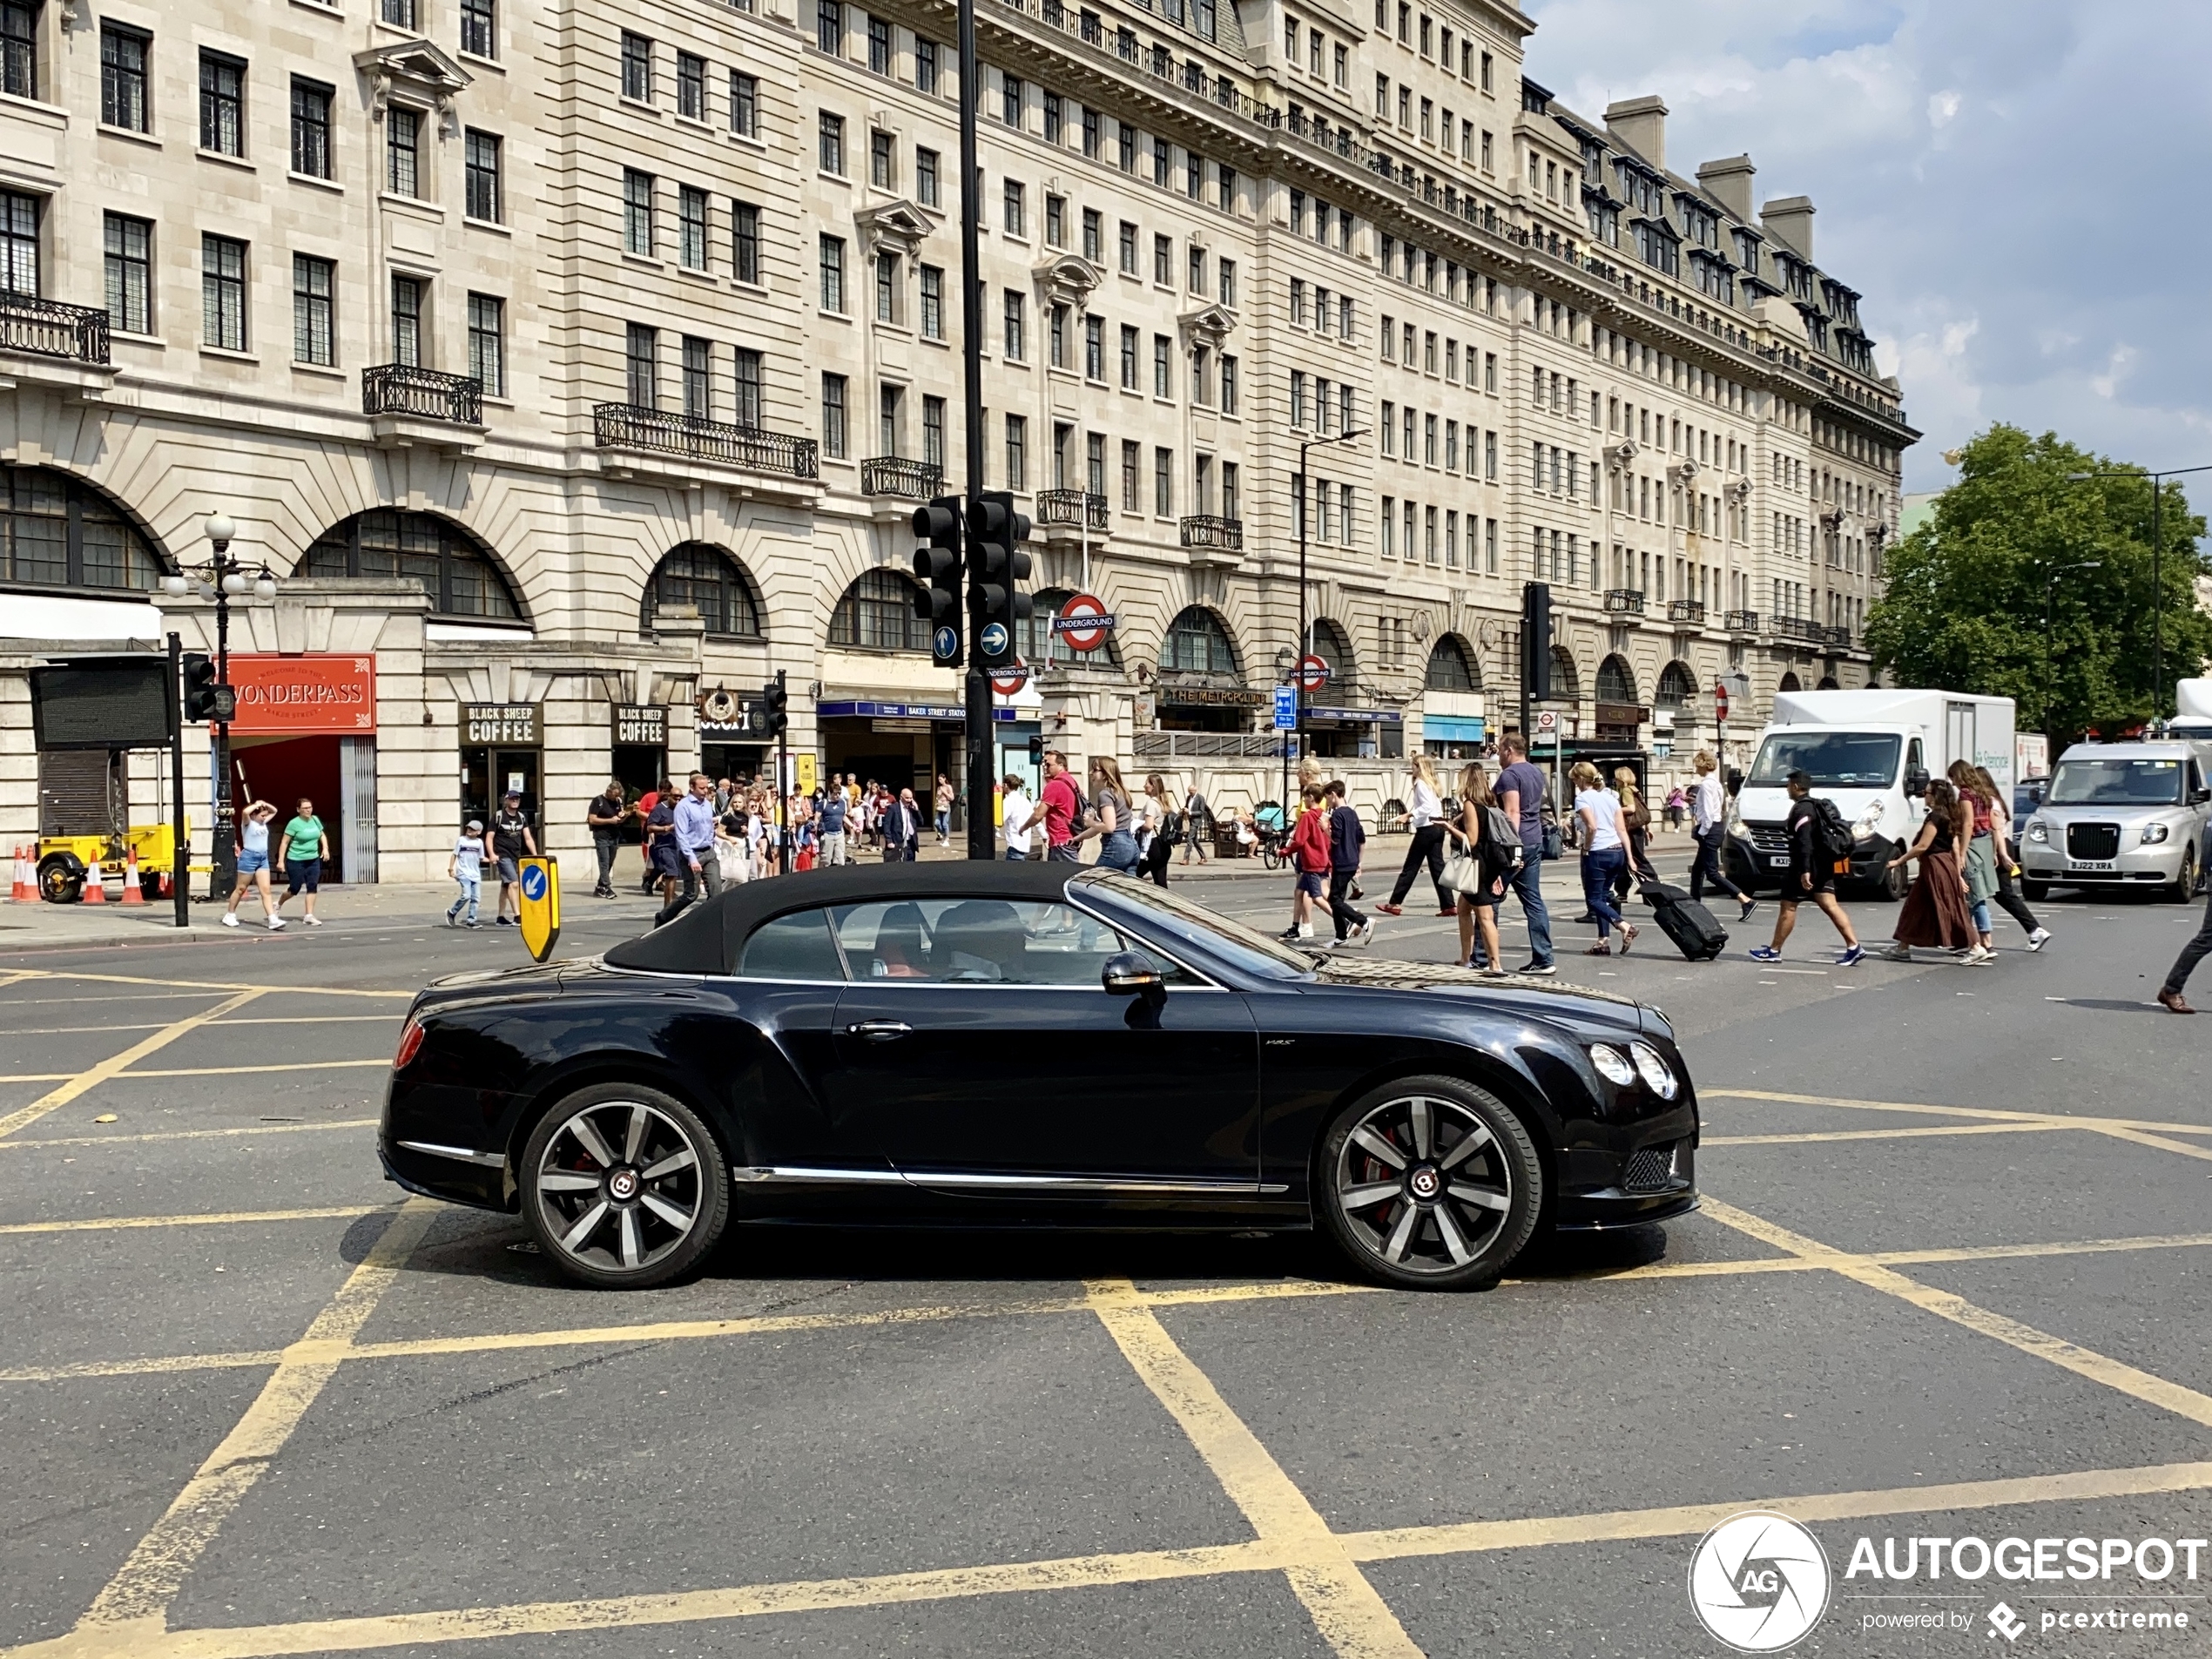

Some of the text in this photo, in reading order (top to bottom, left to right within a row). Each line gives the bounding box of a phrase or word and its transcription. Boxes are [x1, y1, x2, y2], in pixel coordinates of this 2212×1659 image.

[1056, 617, 1113, 629] UNDERGROUND
[988, 669, 1028, 678] NDERGROUND
[1170, 691, 1195, 700] THE
[469, 708, 533, 719] BLACK SHEEP
[618, 708, 662, 721] BLACK SHEEP
[469, 721, 533, 742] COFFEE
[619, 721, 663, 742] COFFEE
[2071, 861, 2093, 870] BJ22
